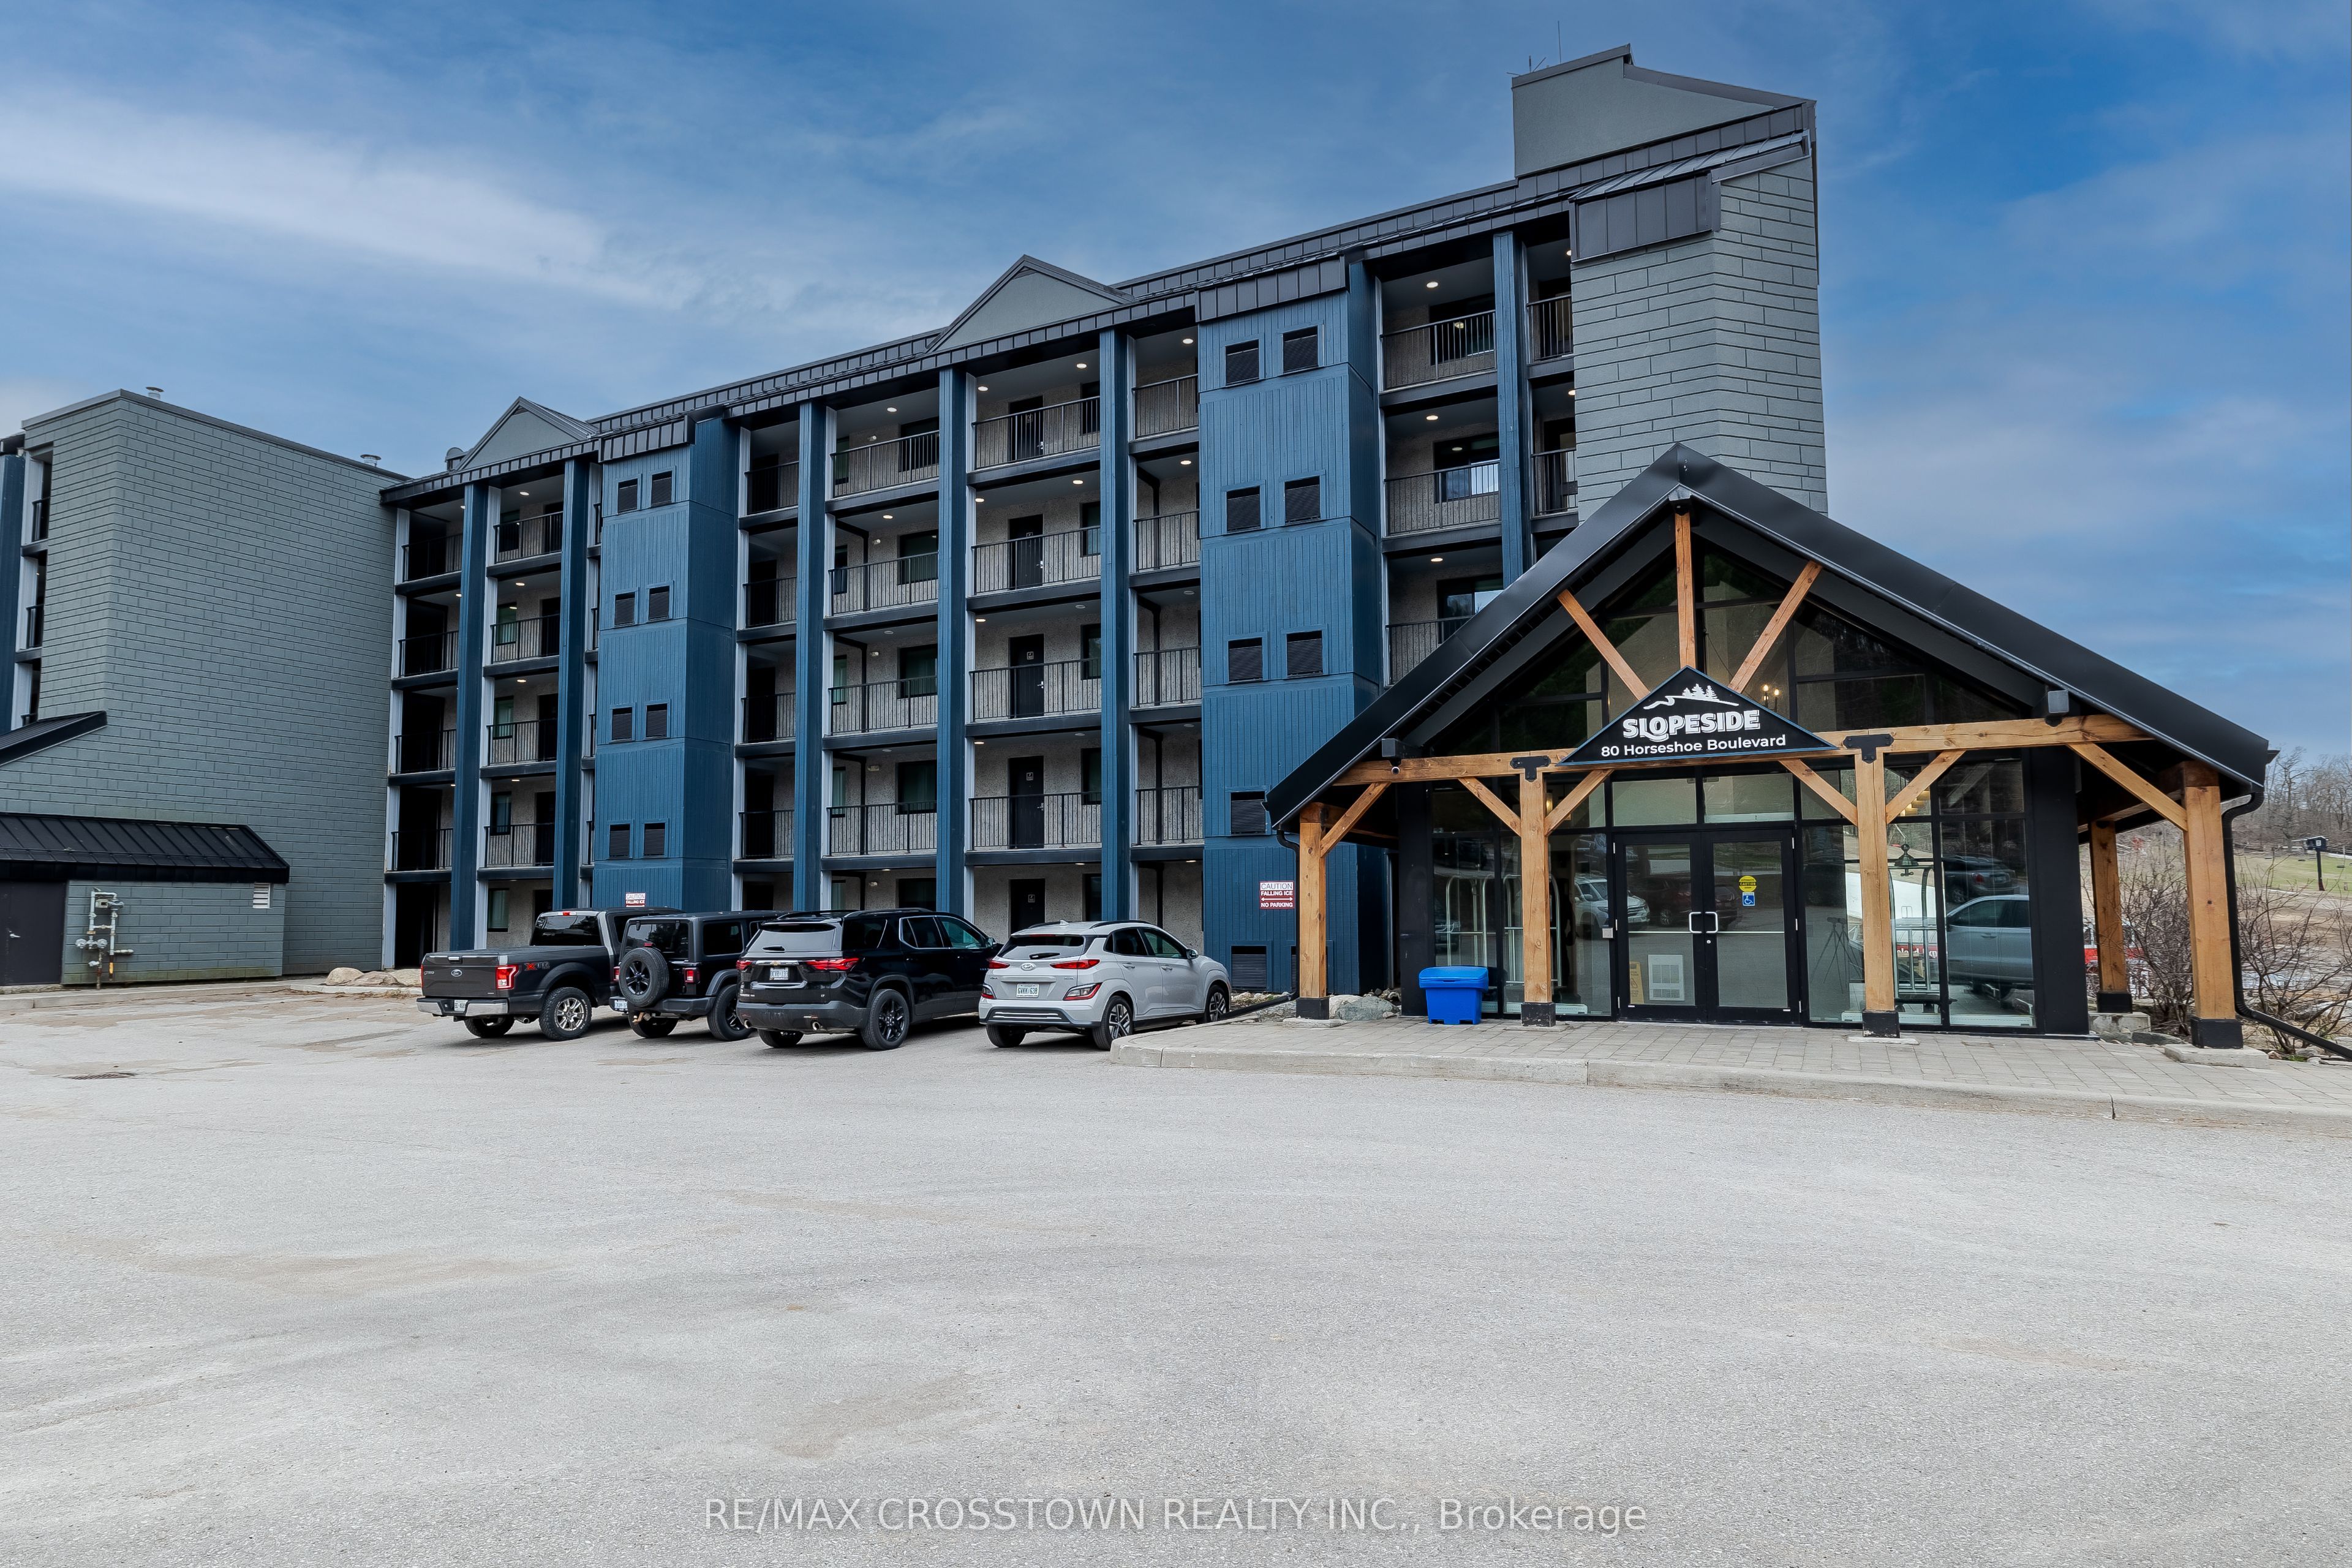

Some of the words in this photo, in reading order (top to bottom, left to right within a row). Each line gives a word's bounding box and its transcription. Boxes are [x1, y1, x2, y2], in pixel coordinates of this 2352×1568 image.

[1623, 710, 1760, 742] SLOPESIDE
[1601, 745, 1620, 757] 80
[1624, 741, 1703, 756] Horseshoe
[1707, 734, 1787, 751] Boulevard
